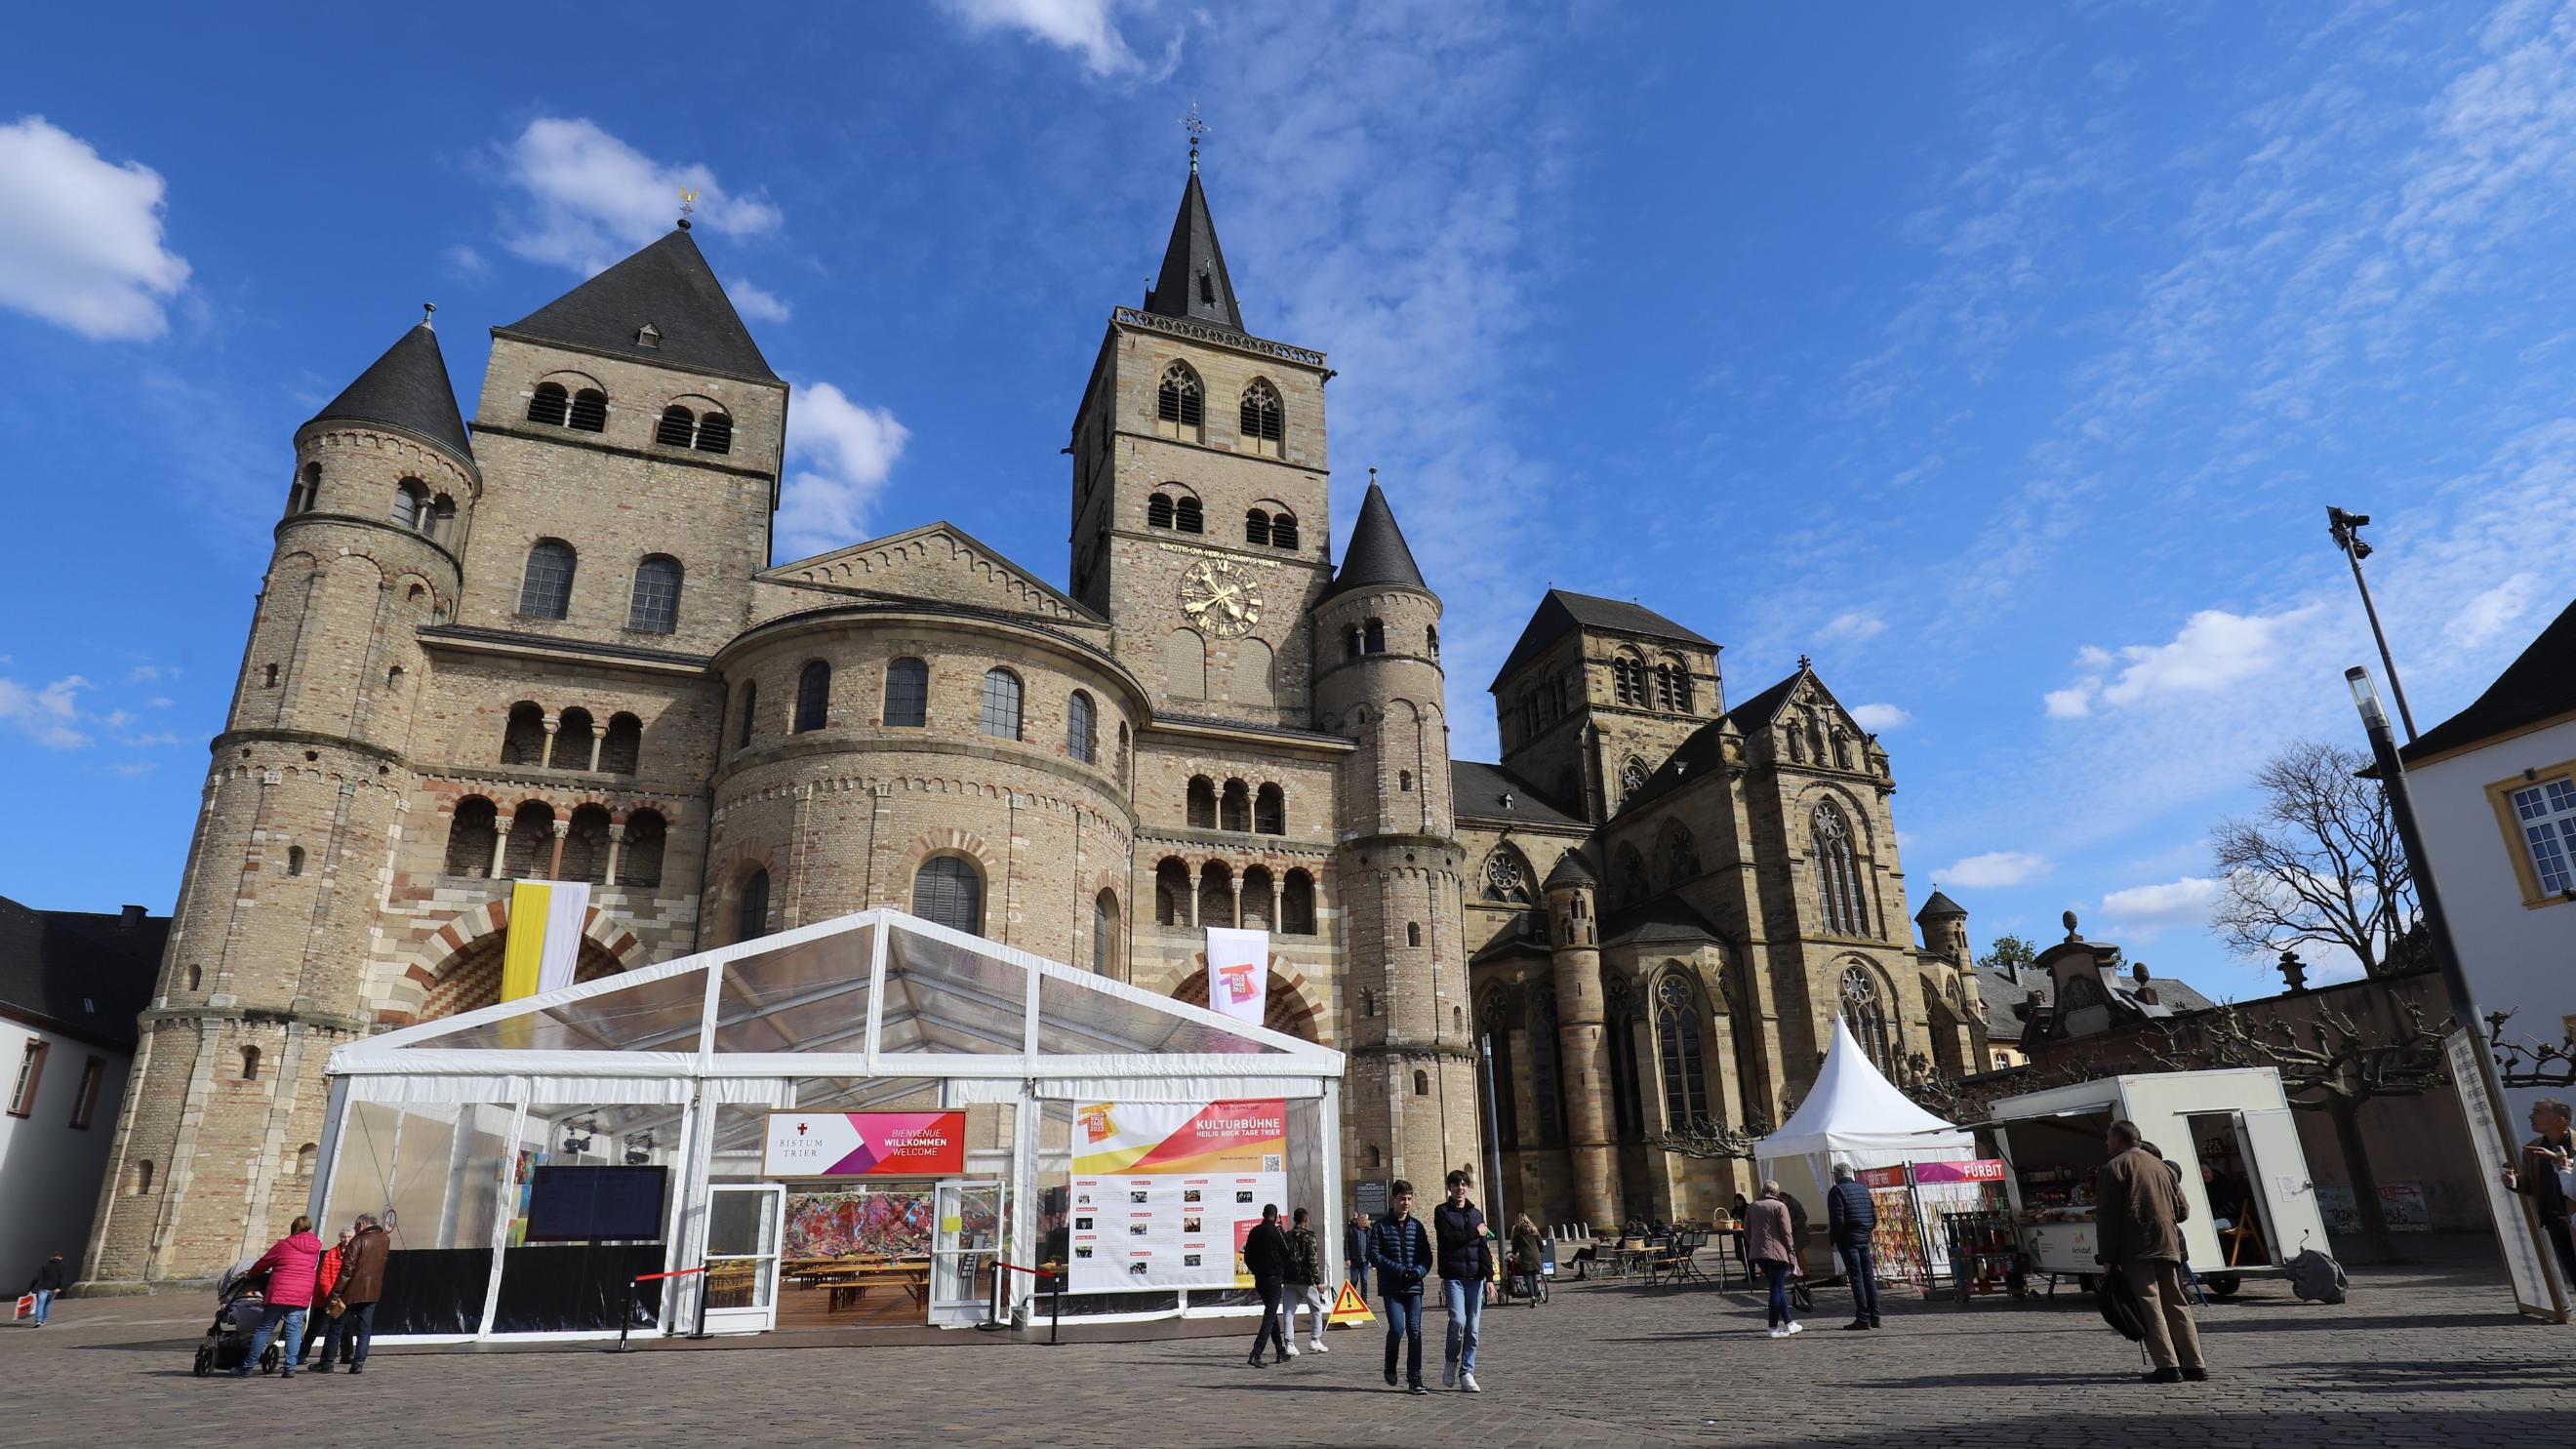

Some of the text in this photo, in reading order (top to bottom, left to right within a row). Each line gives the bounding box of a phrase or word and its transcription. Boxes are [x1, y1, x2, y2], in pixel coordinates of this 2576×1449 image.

[1196, 1117, 1280, 1129] KULTURBÜHNE
[891, 1128, 942, 1138] BIENVENUE
[779, 1139, 823, 1147] BISTUM
[884, 1138, 947, 1147] WILLKOMMEN
[784, 1149, 817, 1157] TRIER
[892, 1147, 938, 1156] WELCOME
